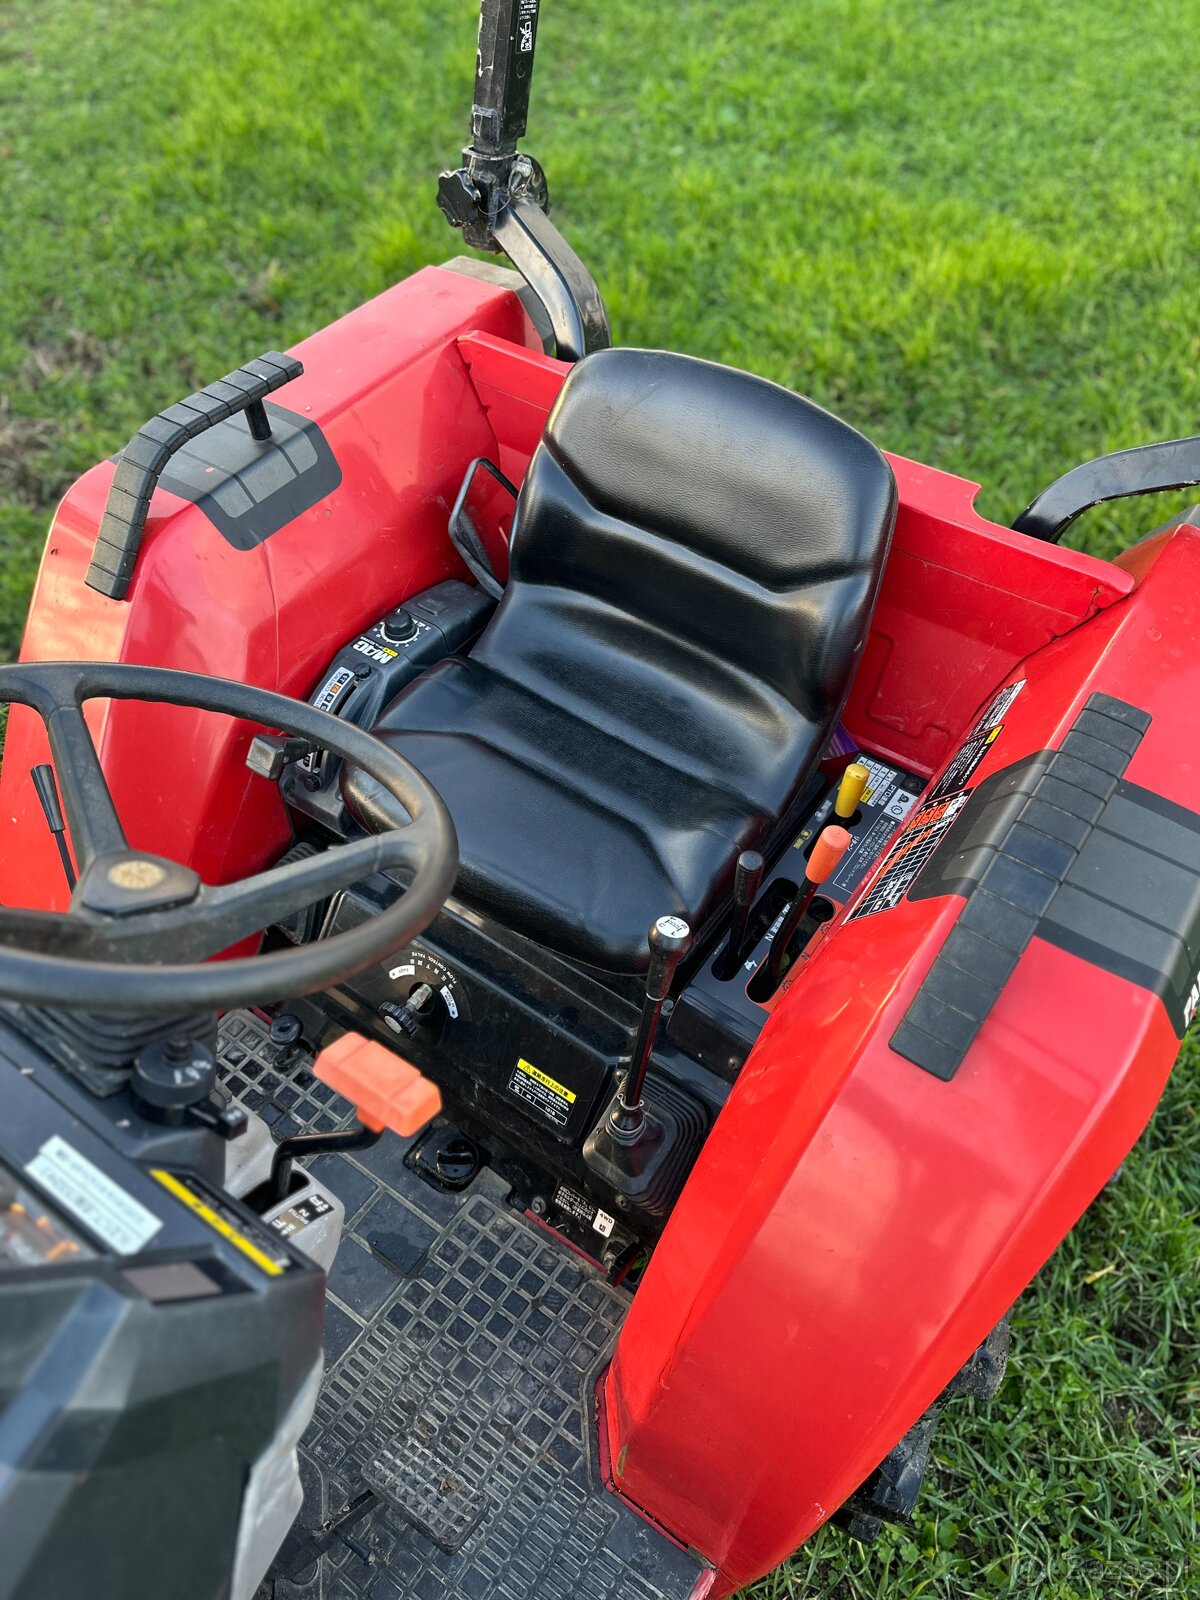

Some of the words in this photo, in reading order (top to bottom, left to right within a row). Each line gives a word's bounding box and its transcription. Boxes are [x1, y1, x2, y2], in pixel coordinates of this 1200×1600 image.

[352, 640, 393, 664] MAC
[764, 933, 774, 941] N
[801, 952, 810, 960] N
[428, 956, 447, 972] CONTROL
[446, 971, 457, 984] FLOW
[309, 1195, 323, 1206] R
[288, 1208, 309, 1225] SHUTTLE
[299, 1208, 309, 1217] N
[600, 1213, 613, 1223] 4WD
[272, 1219, 287, 1230] F
